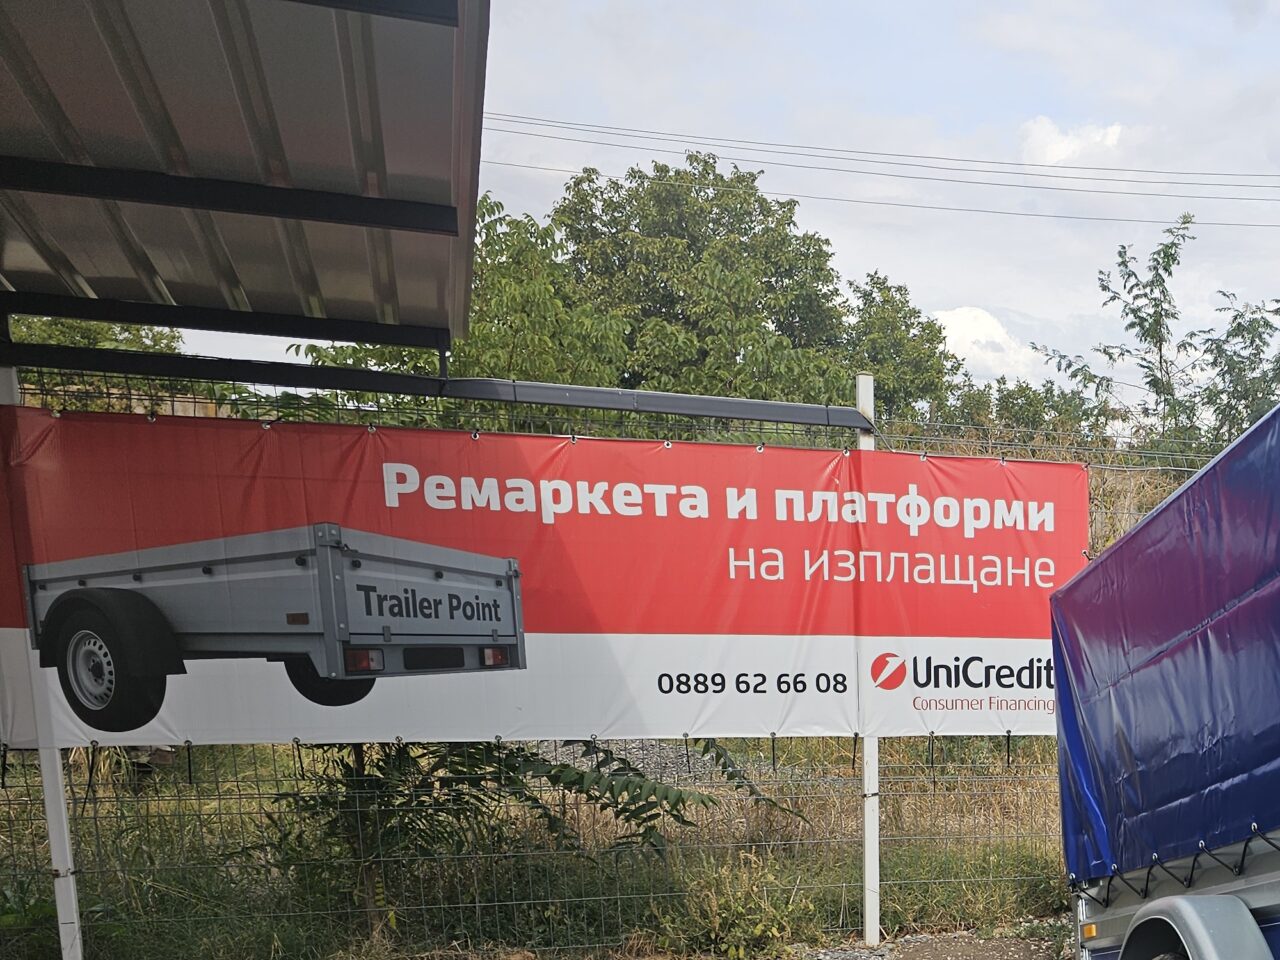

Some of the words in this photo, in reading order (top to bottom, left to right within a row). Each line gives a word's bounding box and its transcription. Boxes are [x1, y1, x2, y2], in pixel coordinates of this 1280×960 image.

[382, 462, 710, 524] Ремаркета
[725, 487, 758, 520] и
[774, 483, 1055, 538] платформи
[728, 547, 785, 581] на
[804, 548, 1056, 594] изплащане
[356, 583, 442, 620] Trailer
[447, 592, 502, 623] Point
[657, 672, 726, 694] 0889
[735, 672, 767, 694] 62
[776, 672, 807, 694] 66
[815, 672, 848, 694] 08
[912, 655, 1055, 690] UniCredit
[912, 695, 985, 712] Consumer
[988, 695, 1056, 716] Financing
